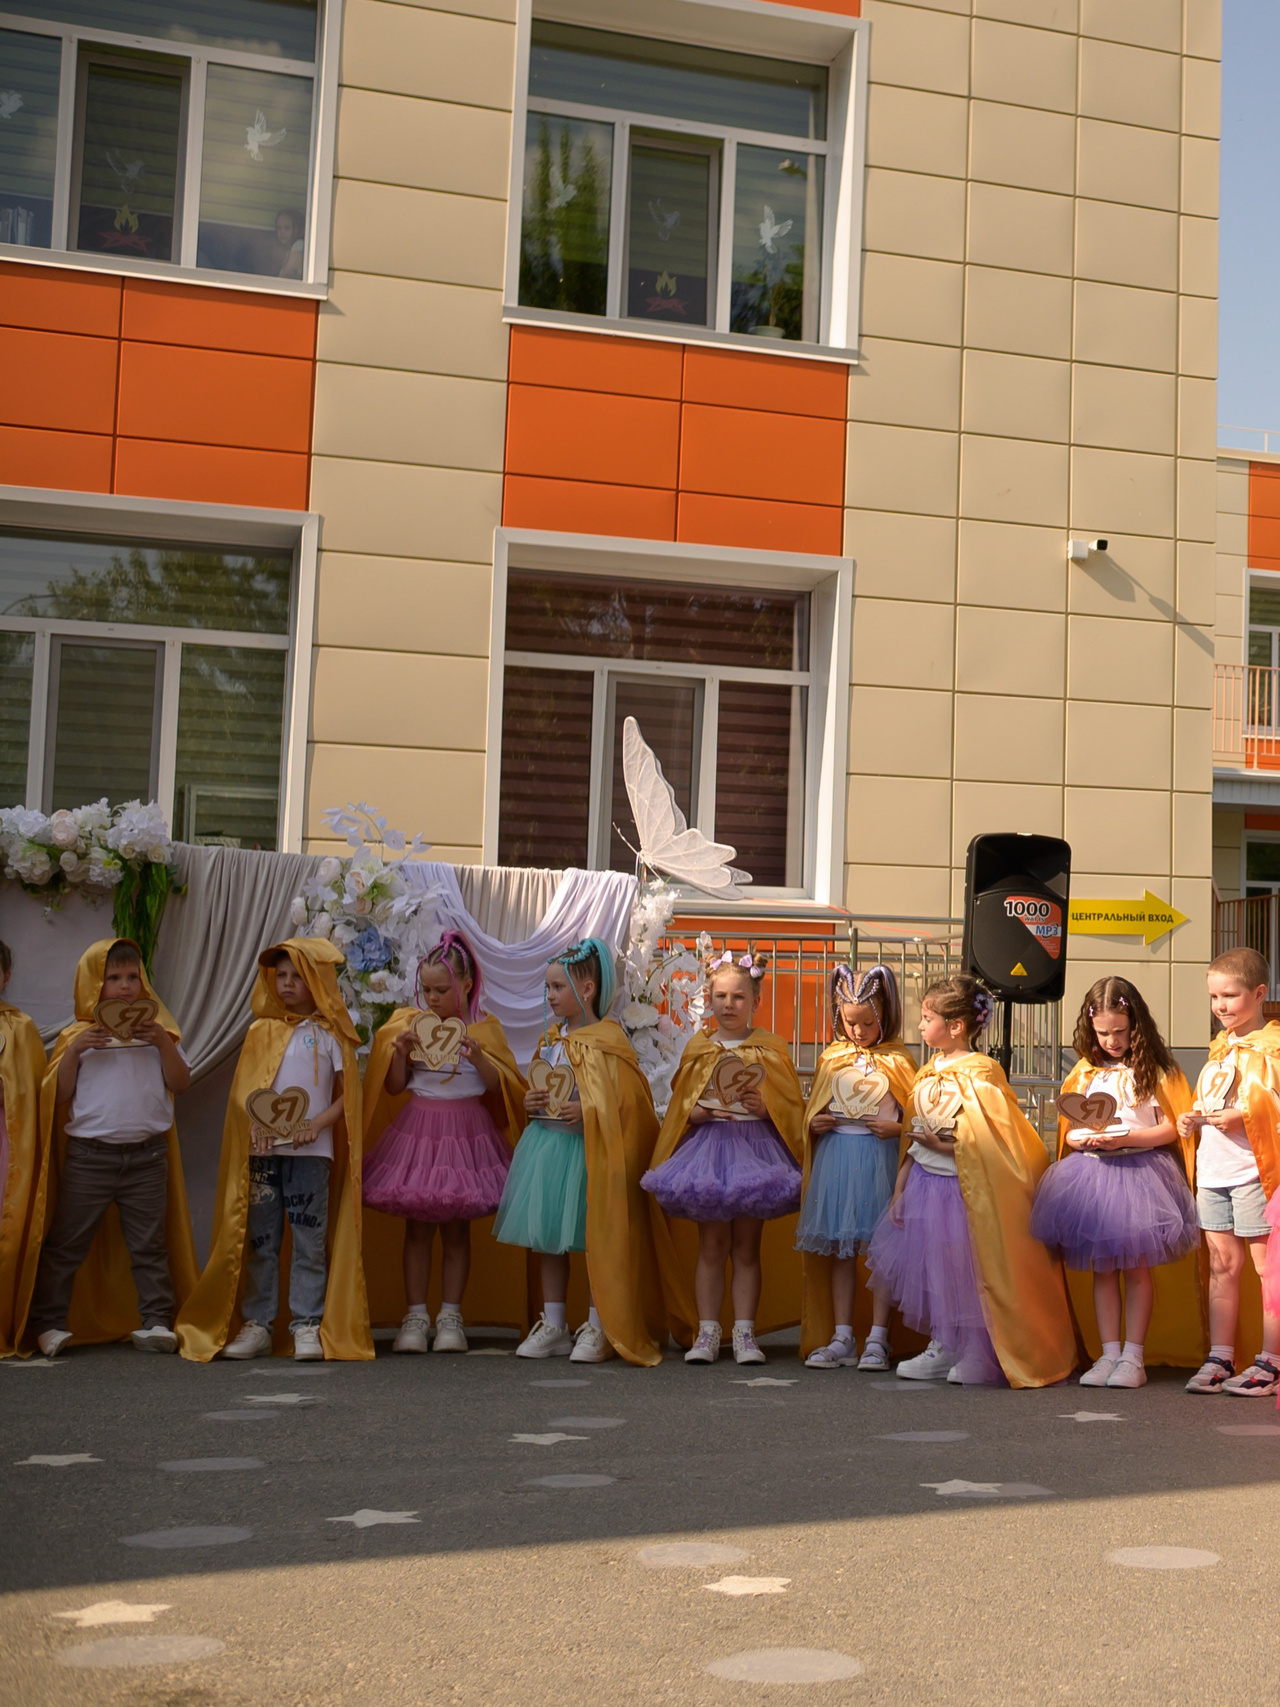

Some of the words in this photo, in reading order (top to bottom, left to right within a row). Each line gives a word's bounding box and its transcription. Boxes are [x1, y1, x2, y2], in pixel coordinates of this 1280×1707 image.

[1004, 900, 1050, 917] 1000
[1072, 912, 1145, 922] ЦЕНТРАЛЬНЫЙ
[1148, 914, 1174, 923] ВХОД
[1035, 925, 1058, 936] MP3
